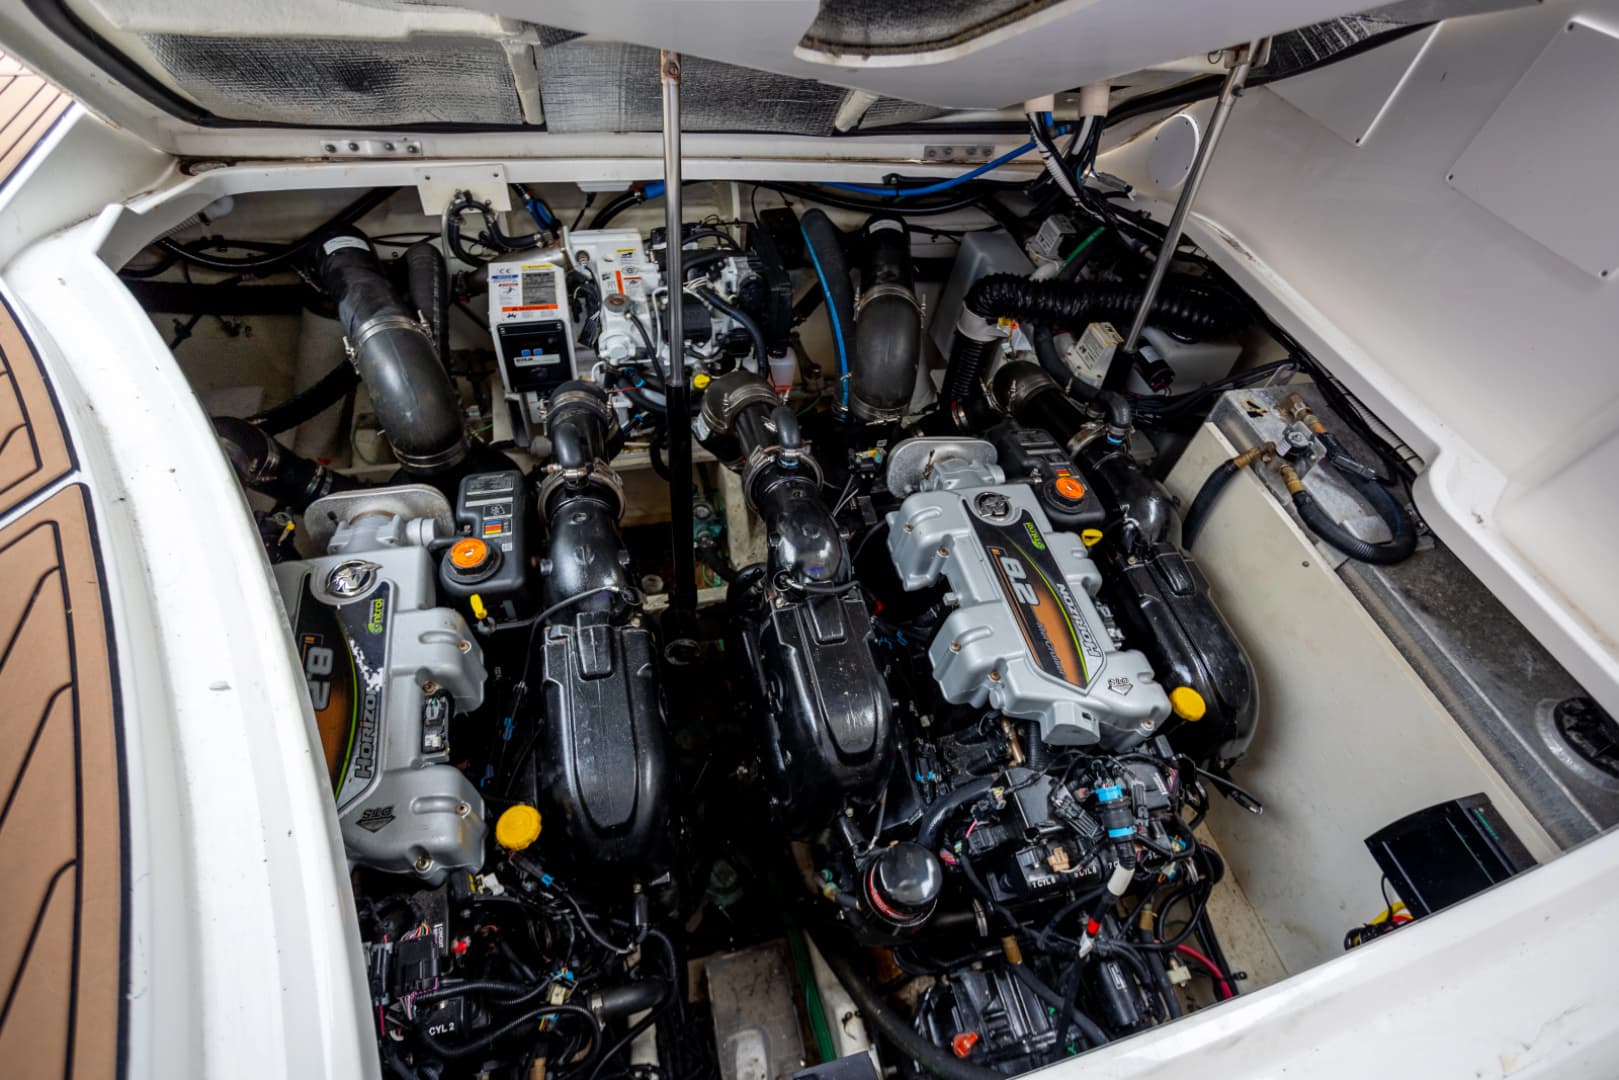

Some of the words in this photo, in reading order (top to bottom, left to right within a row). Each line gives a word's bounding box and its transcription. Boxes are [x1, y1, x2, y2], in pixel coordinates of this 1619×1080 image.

[1000, 556, 1040, 606] 8.2
[428, 1024, 448, 1037] CYL
[448, 1021, 456, 1032] 2
